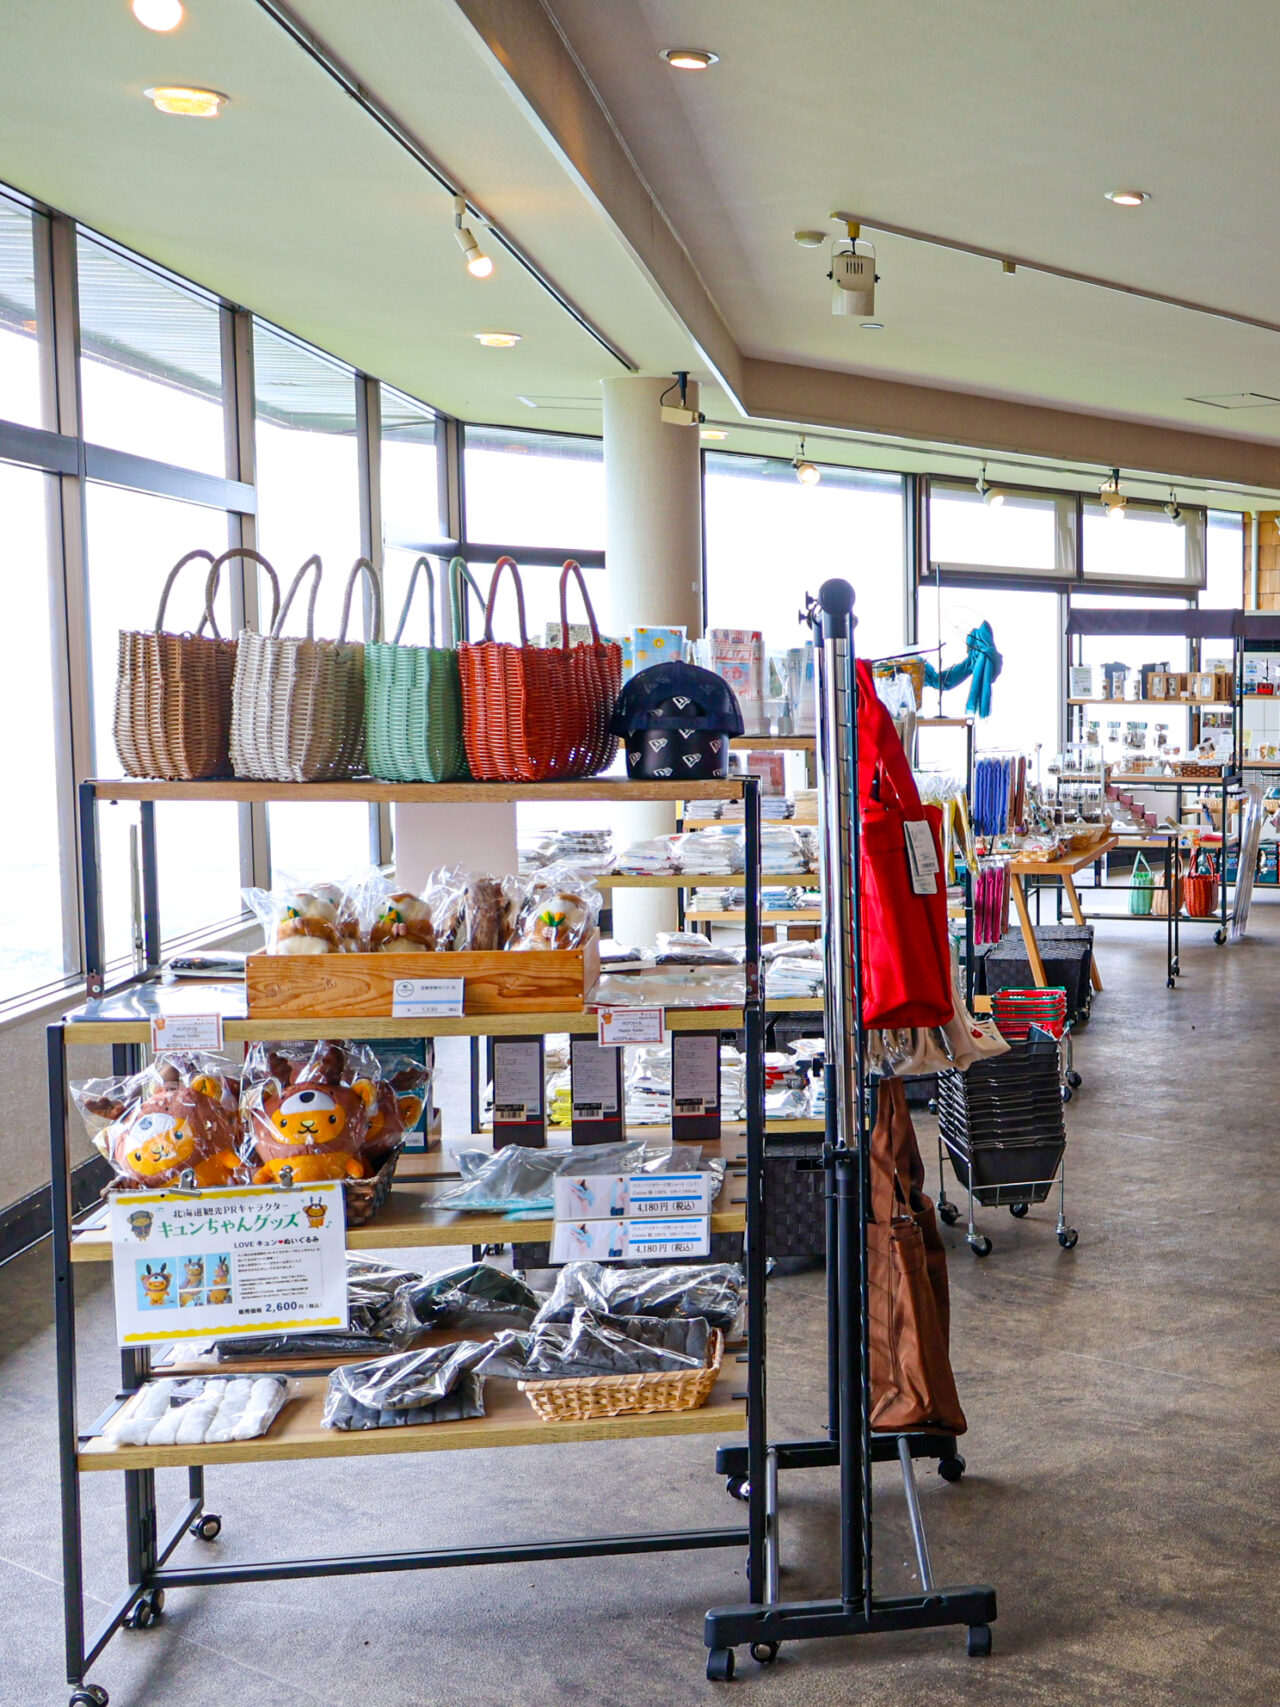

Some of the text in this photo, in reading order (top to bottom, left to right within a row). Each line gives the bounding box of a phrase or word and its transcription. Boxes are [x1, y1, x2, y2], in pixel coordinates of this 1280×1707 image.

[173, 1202, 289, 1218] 北海道観光PRキャラクター
[158, 1211, 301, 1239] キュンちゃんグッズ
[233, 1240, 254, 1249] LOVE
